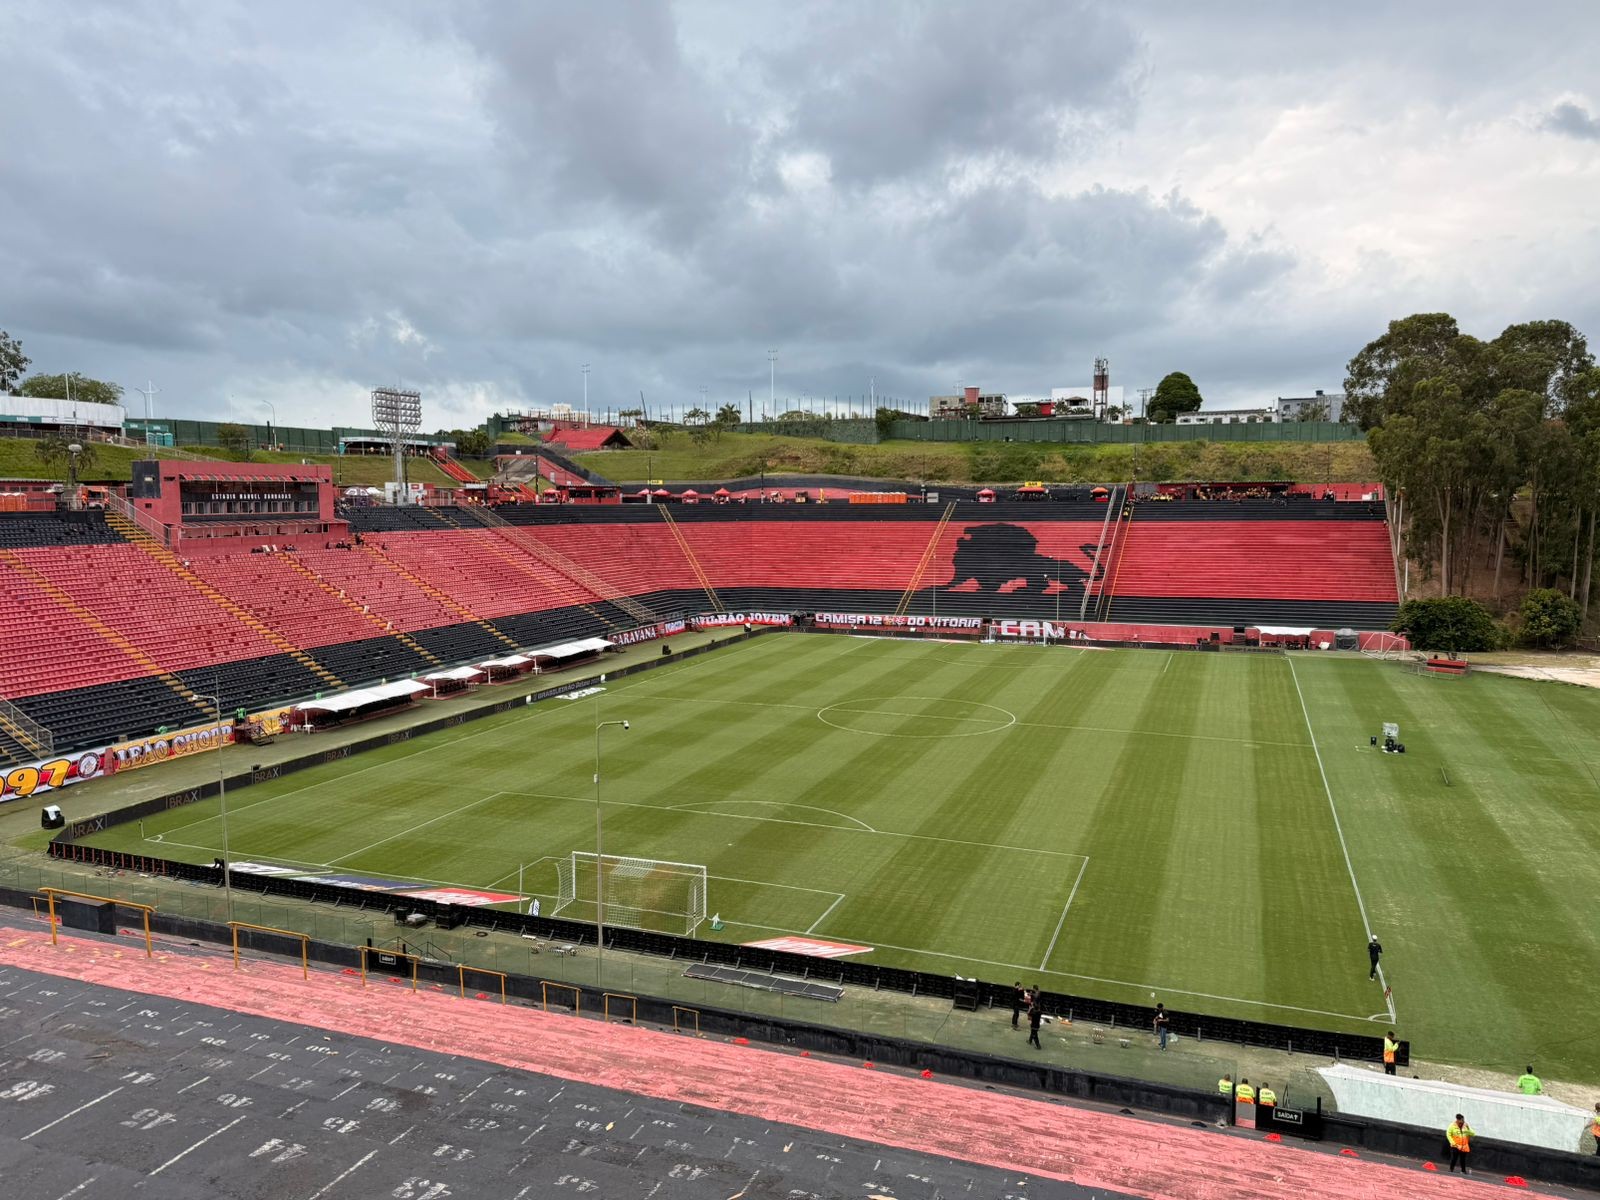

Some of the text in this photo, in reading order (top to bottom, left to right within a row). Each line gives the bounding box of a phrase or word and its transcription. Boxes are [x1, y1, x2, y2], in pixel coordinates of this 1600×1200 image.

[815, 613, 866, 625] CAMISA
[868, 615, 882, 625] 12
[906, 616, 925, 626] DO
[327, 747, 349, 762] BRAX
[0, 759, 71, 797] 97
[254, 767, 279, 783] BRAX
[169, 789, 198, 809] BRAX
[1277, 1111, 1294, 1119] SAÍDA
[248, 1137, 309, 1163] 44
